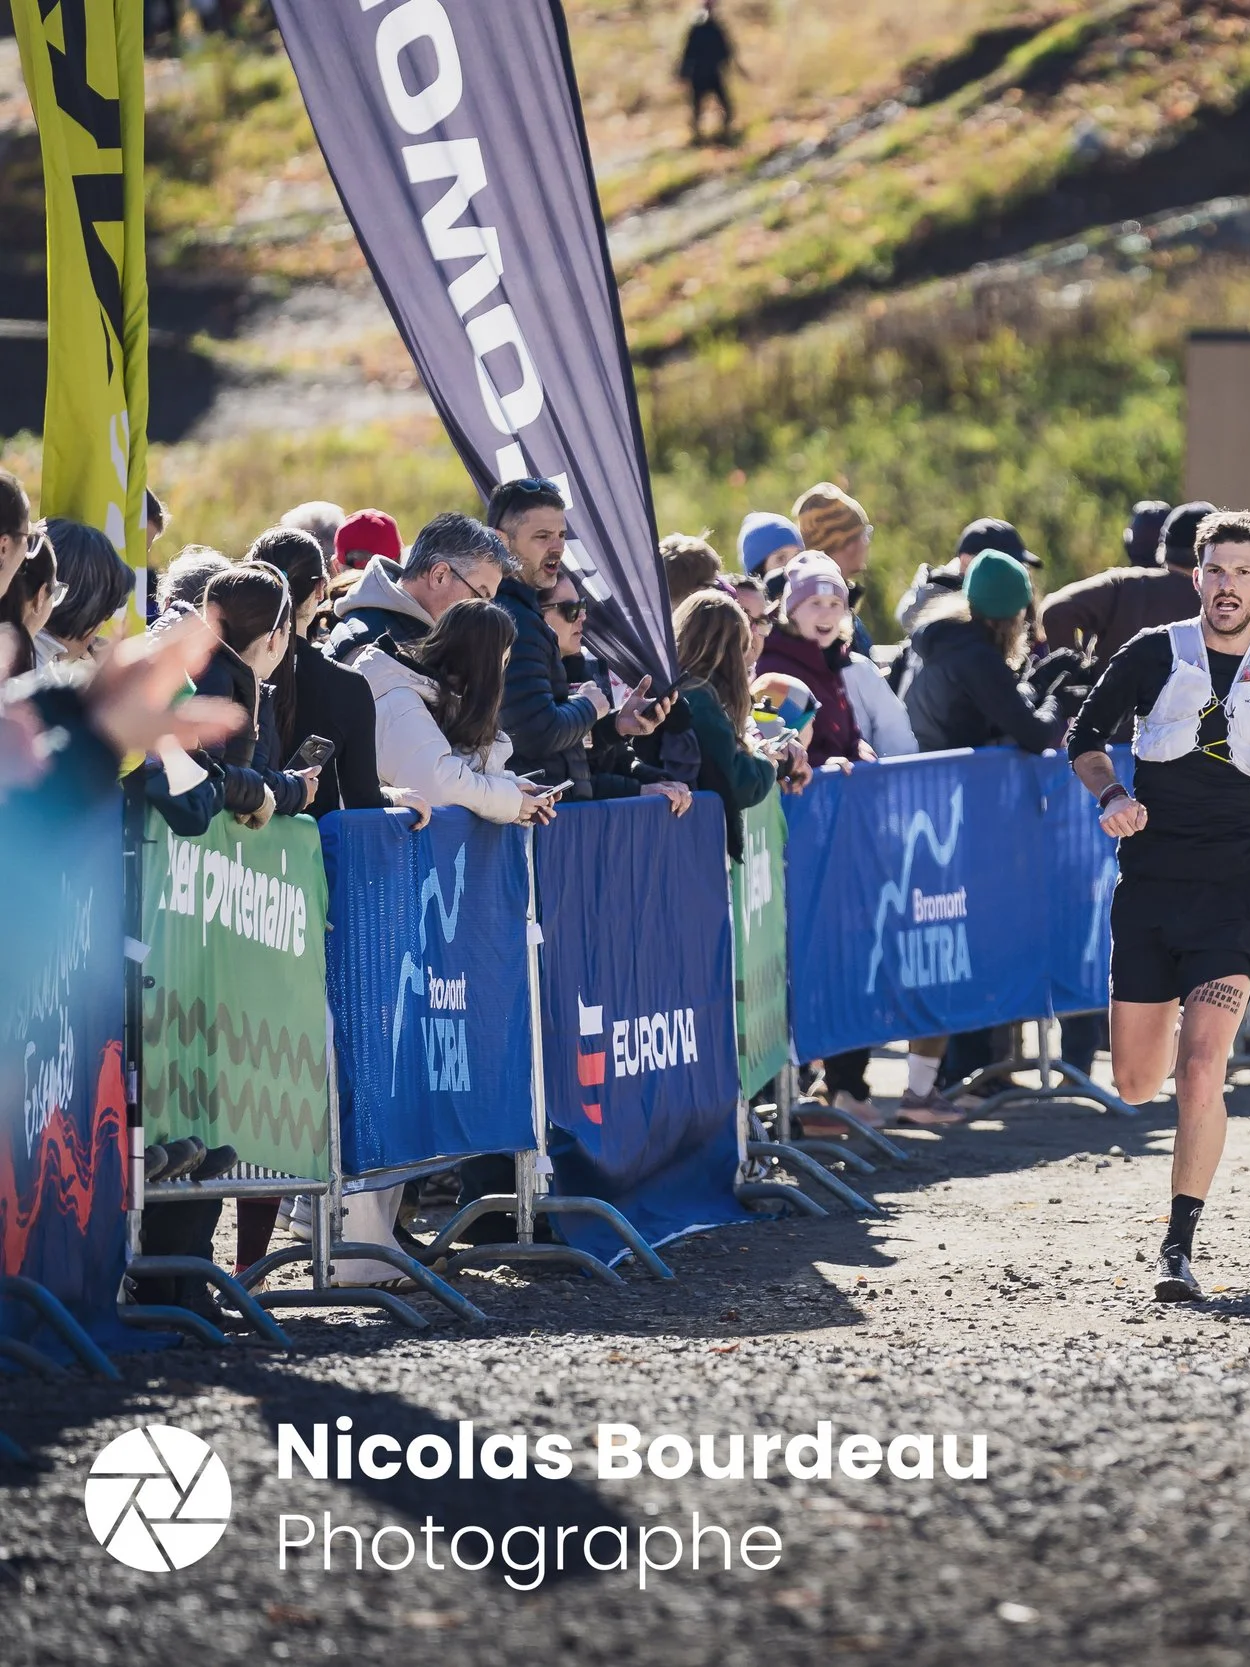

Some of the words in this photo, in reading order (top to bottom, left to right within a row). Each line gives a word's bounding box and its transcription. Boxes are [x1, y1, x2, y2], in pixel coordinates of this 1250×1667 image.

[912, 885, 967, 924] Bromont
[897, 922, 973, 988] ULTRA
[612, 1007, 699, 1078] EUROVIA
